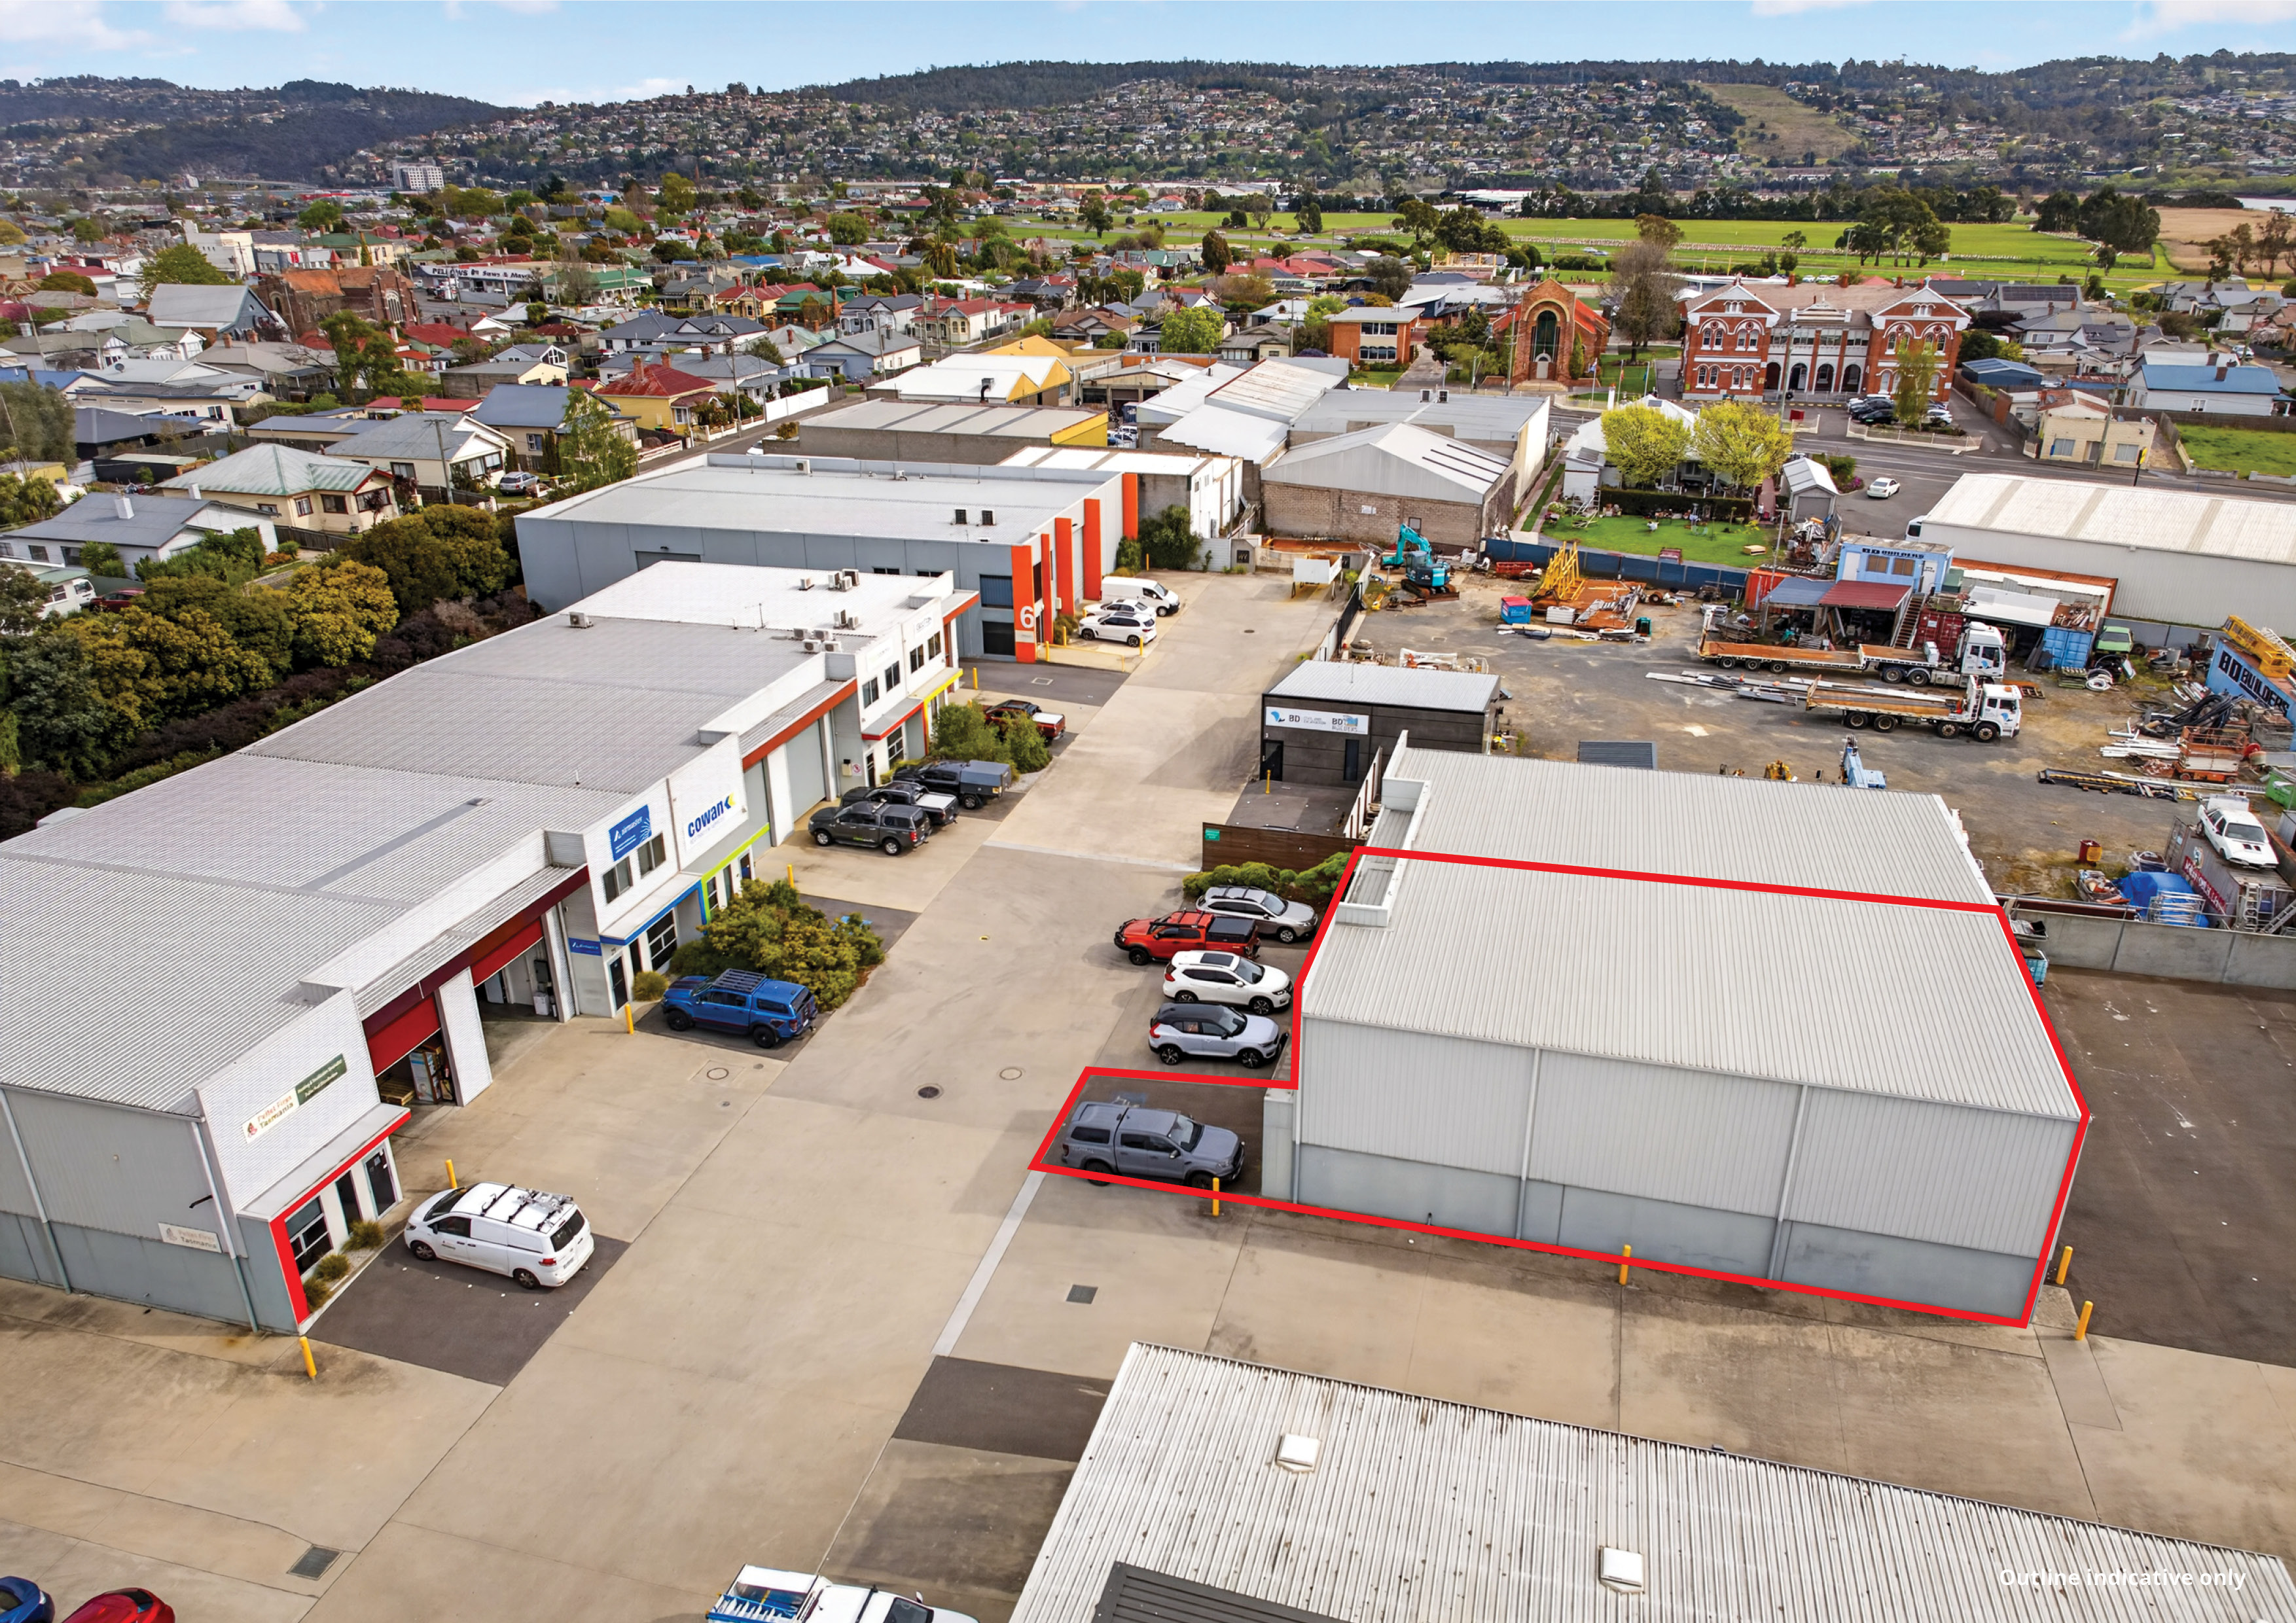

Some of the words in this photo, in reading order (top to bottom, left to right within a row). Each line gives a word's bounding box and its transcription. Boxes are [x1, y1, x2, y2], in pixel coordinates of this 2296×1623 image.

[1020, 605, 1034, 628] 6
[2218, 650, 2243, 683] BD
[2240, 668, 2289, 717] BUILDERS
[688, 800, 724, 838] cowan
[259, 1102, 294, 1129] Tasmania
